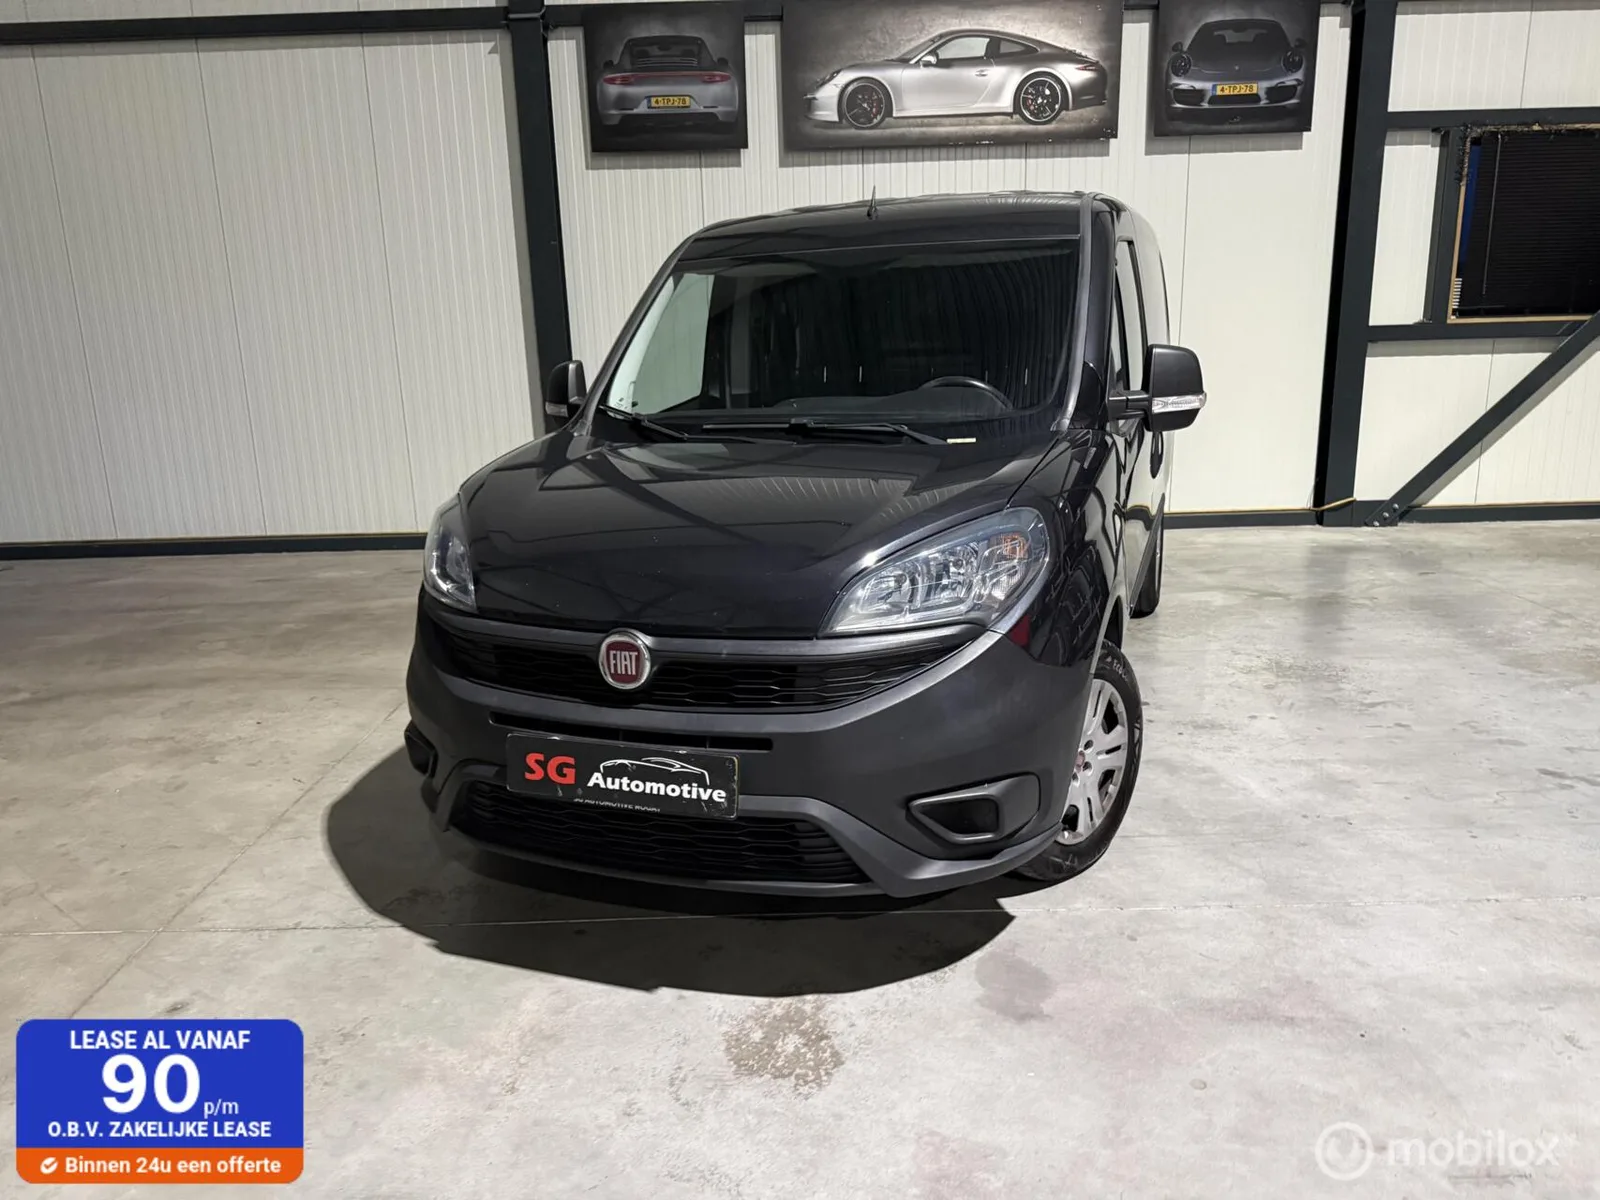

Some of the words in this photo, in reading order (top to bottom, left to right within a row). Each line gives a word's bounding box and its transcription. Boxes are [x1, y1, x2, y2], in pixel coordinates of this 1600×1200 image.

[609, 650, 638, 676] FIAT
[524, 752, 576, 784] SG
[587, 772, 727, 803] Automotive
